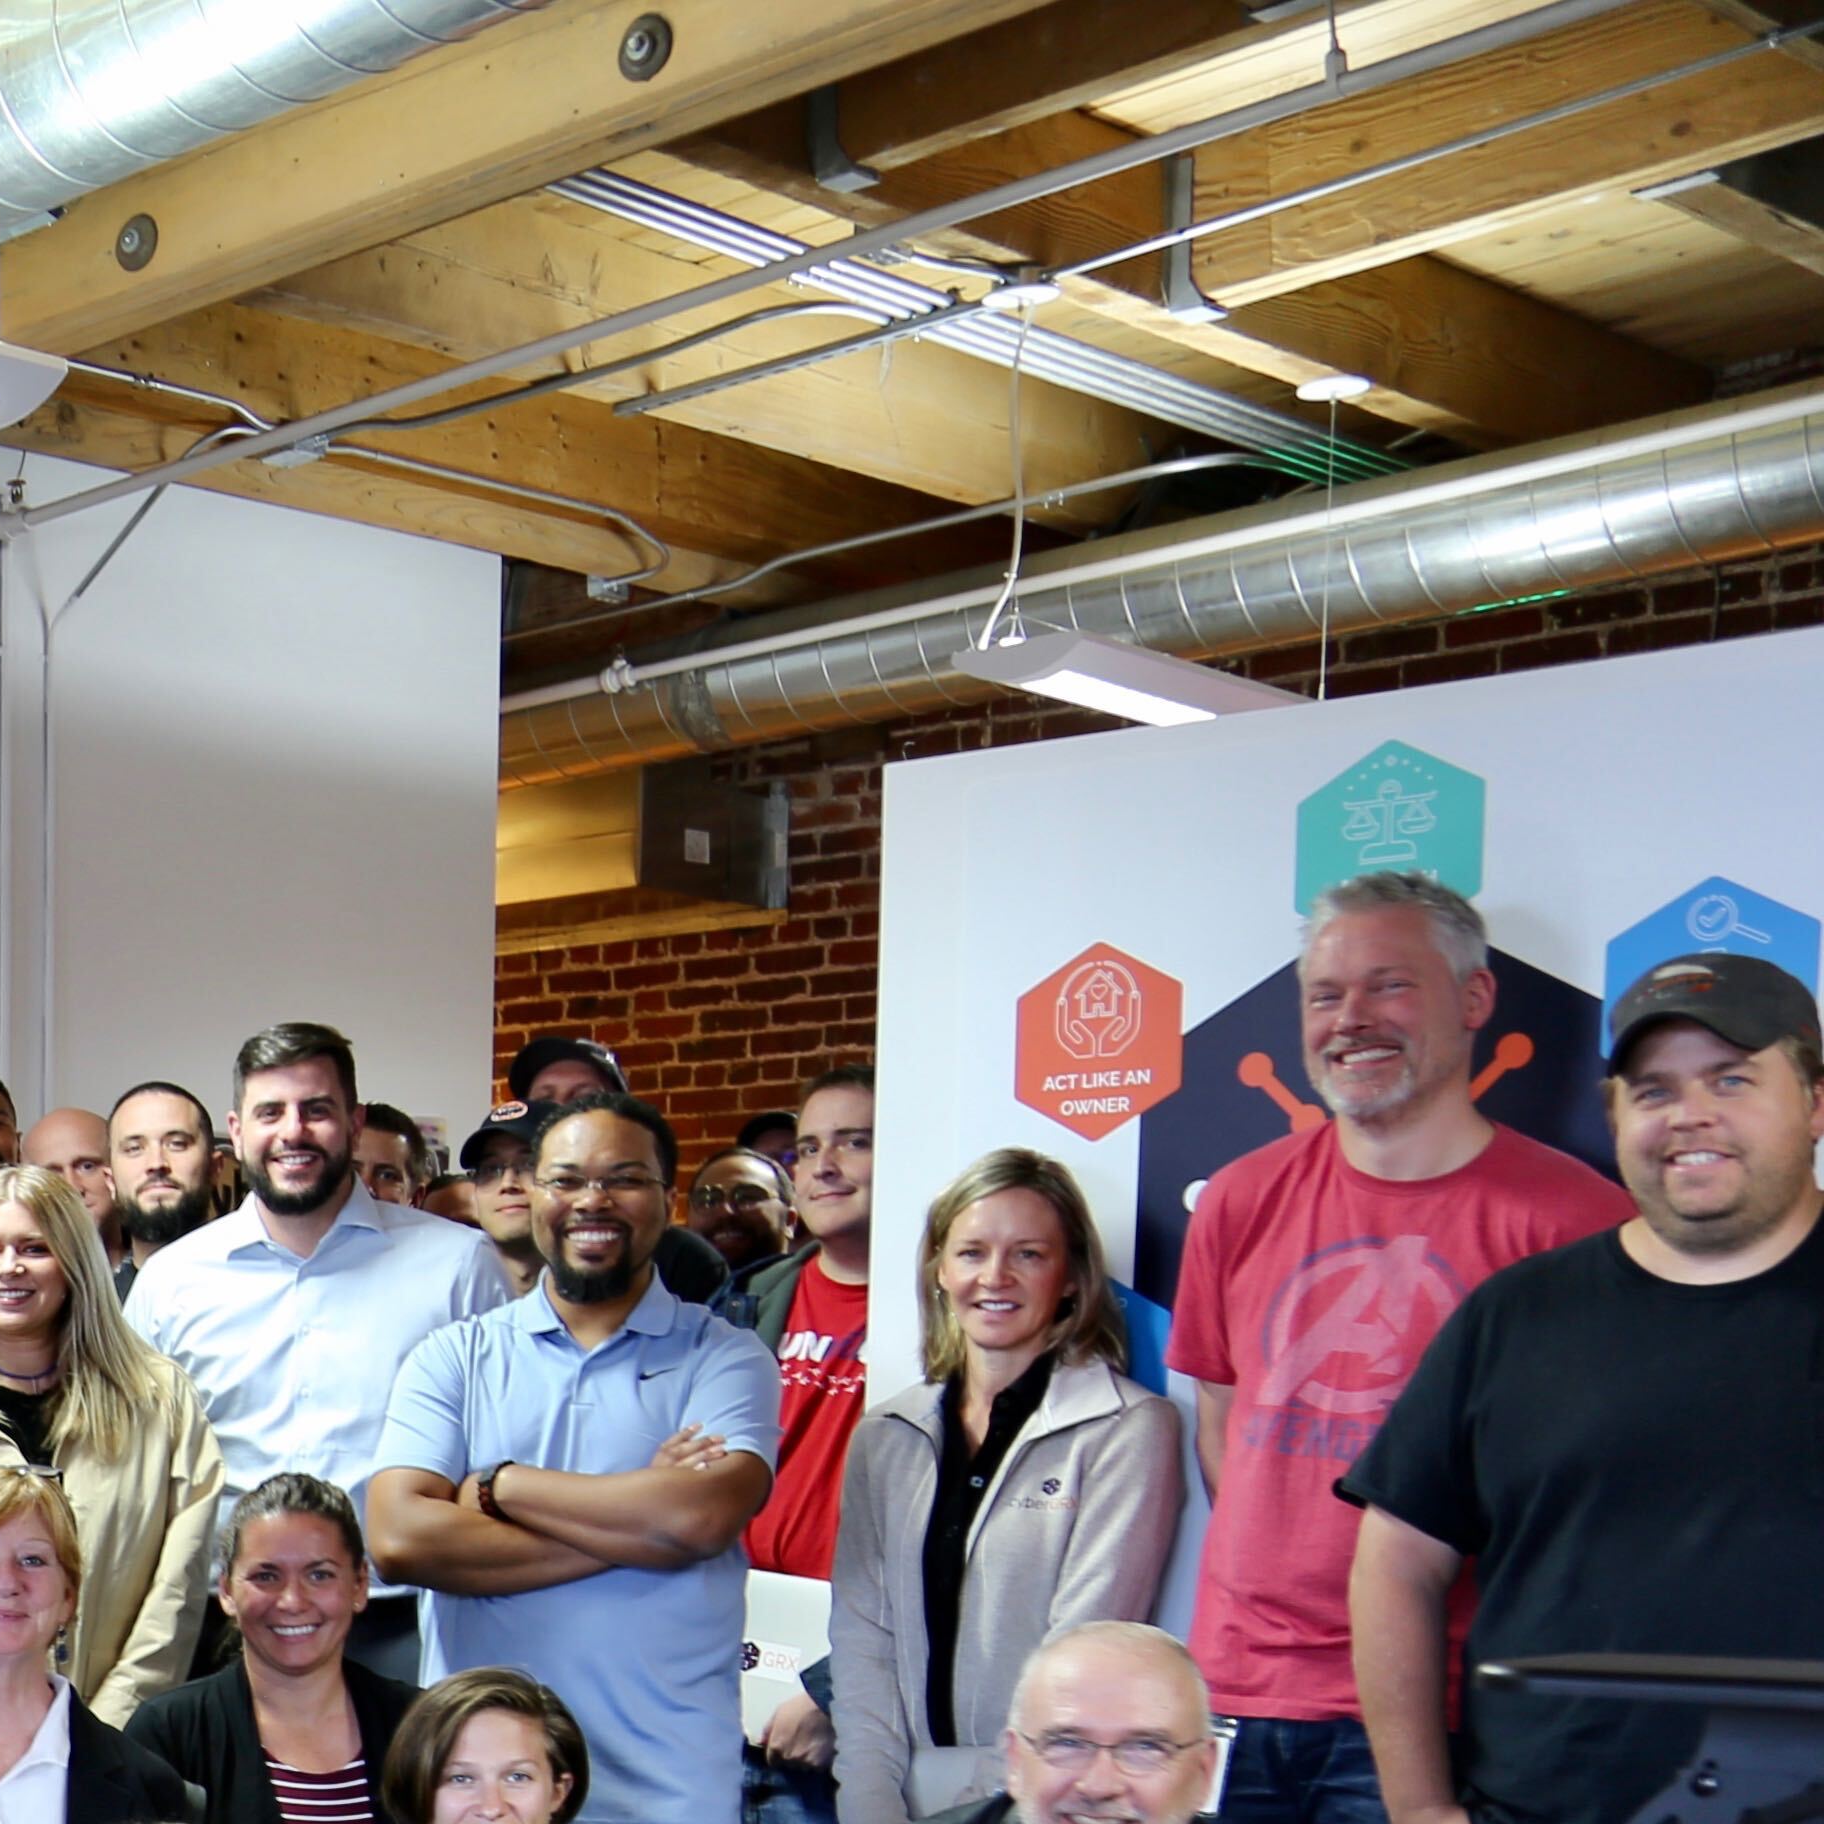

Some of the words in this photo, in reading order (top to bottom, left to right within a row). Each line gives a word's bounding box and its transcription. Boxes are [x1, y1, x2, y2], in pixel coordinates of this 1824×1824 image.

[1042, 1073, 1079, 1092] ACT
[1082, 1071, 1121, 1090] LIKE
[1124, 1069, 1151, 1086] AN
[1059, 1096, 1131, 1116] OWNER
[763, 1651, 800, 1673] GRX
